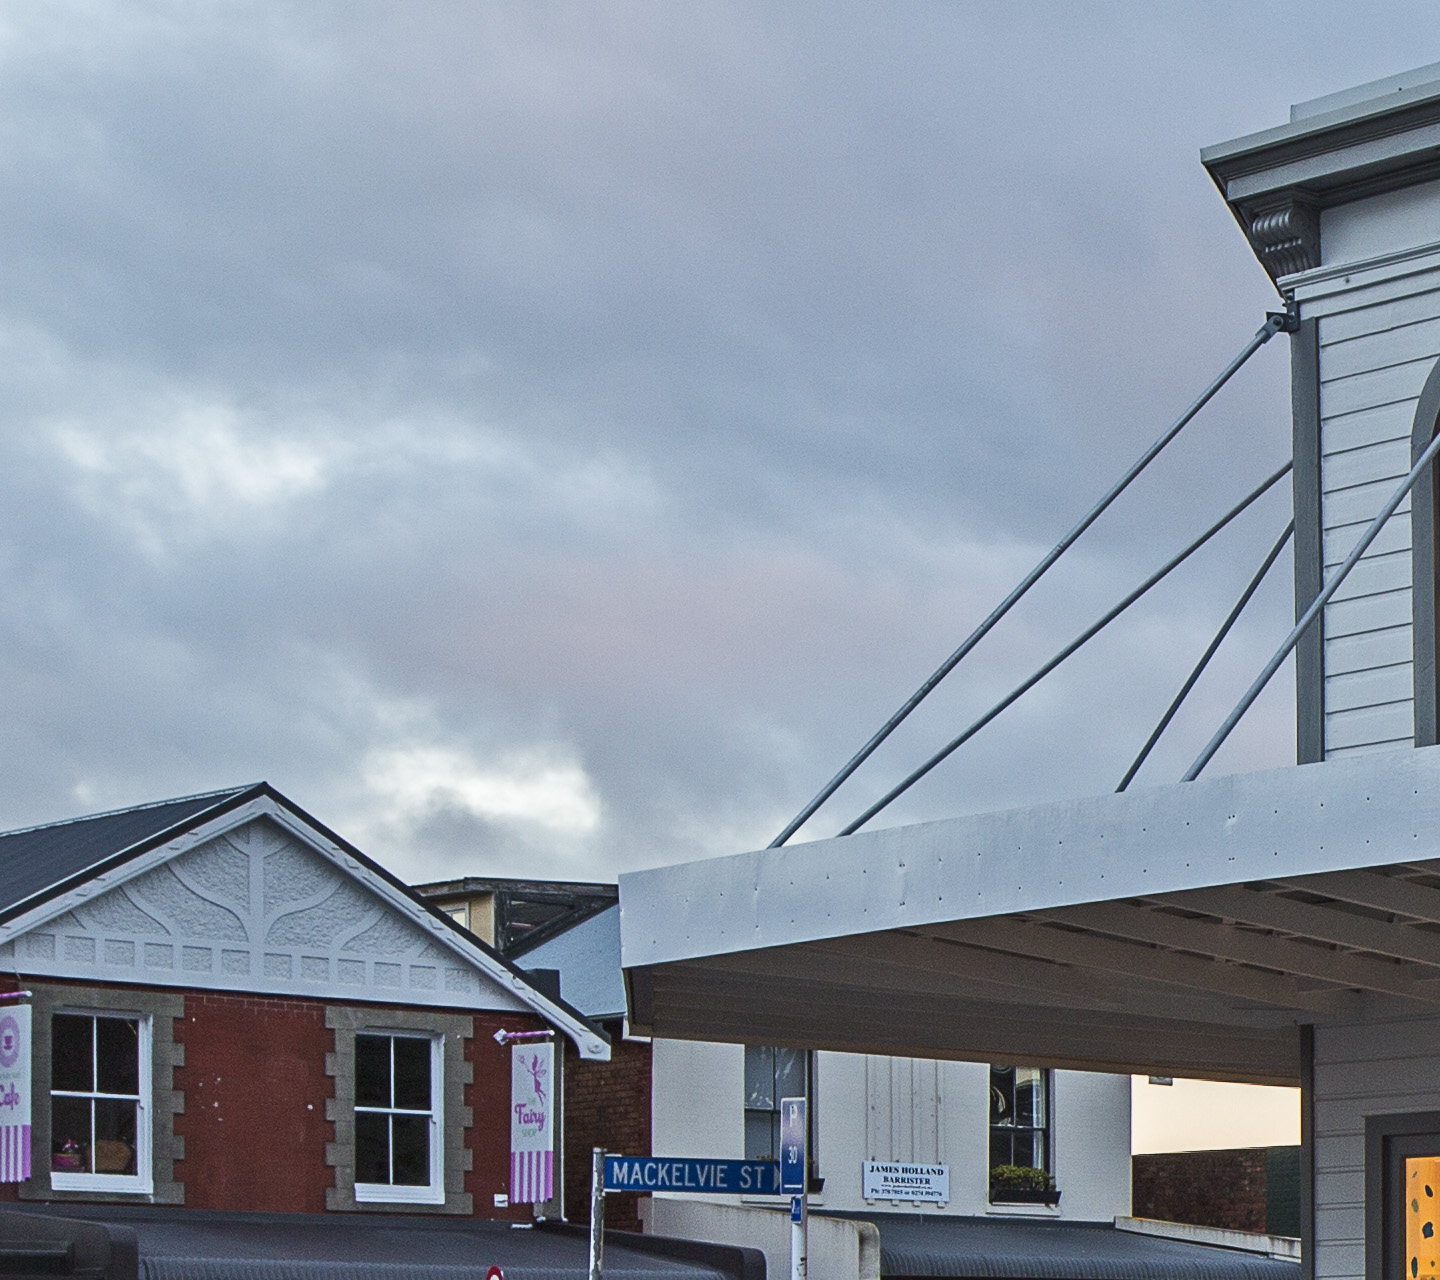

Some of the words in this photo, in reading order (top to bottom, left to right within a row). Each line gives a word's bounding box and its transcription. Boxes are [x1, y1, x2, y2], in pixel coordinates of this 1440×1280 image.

[514, 1103, 546, 1132] Fairy
[789, 1104, 798, 1127] P
[788, 1145, 798, 1164] 30
[612, 1161, 728, 1189] MACKELVIE
[739, 1165, 766, 1189] ST
[869, 1165, 900, 1174] JAMES
[901, 1166, 944, 1176] HOLLAND
[883, 1176, 931, 1185] BARRISTER
